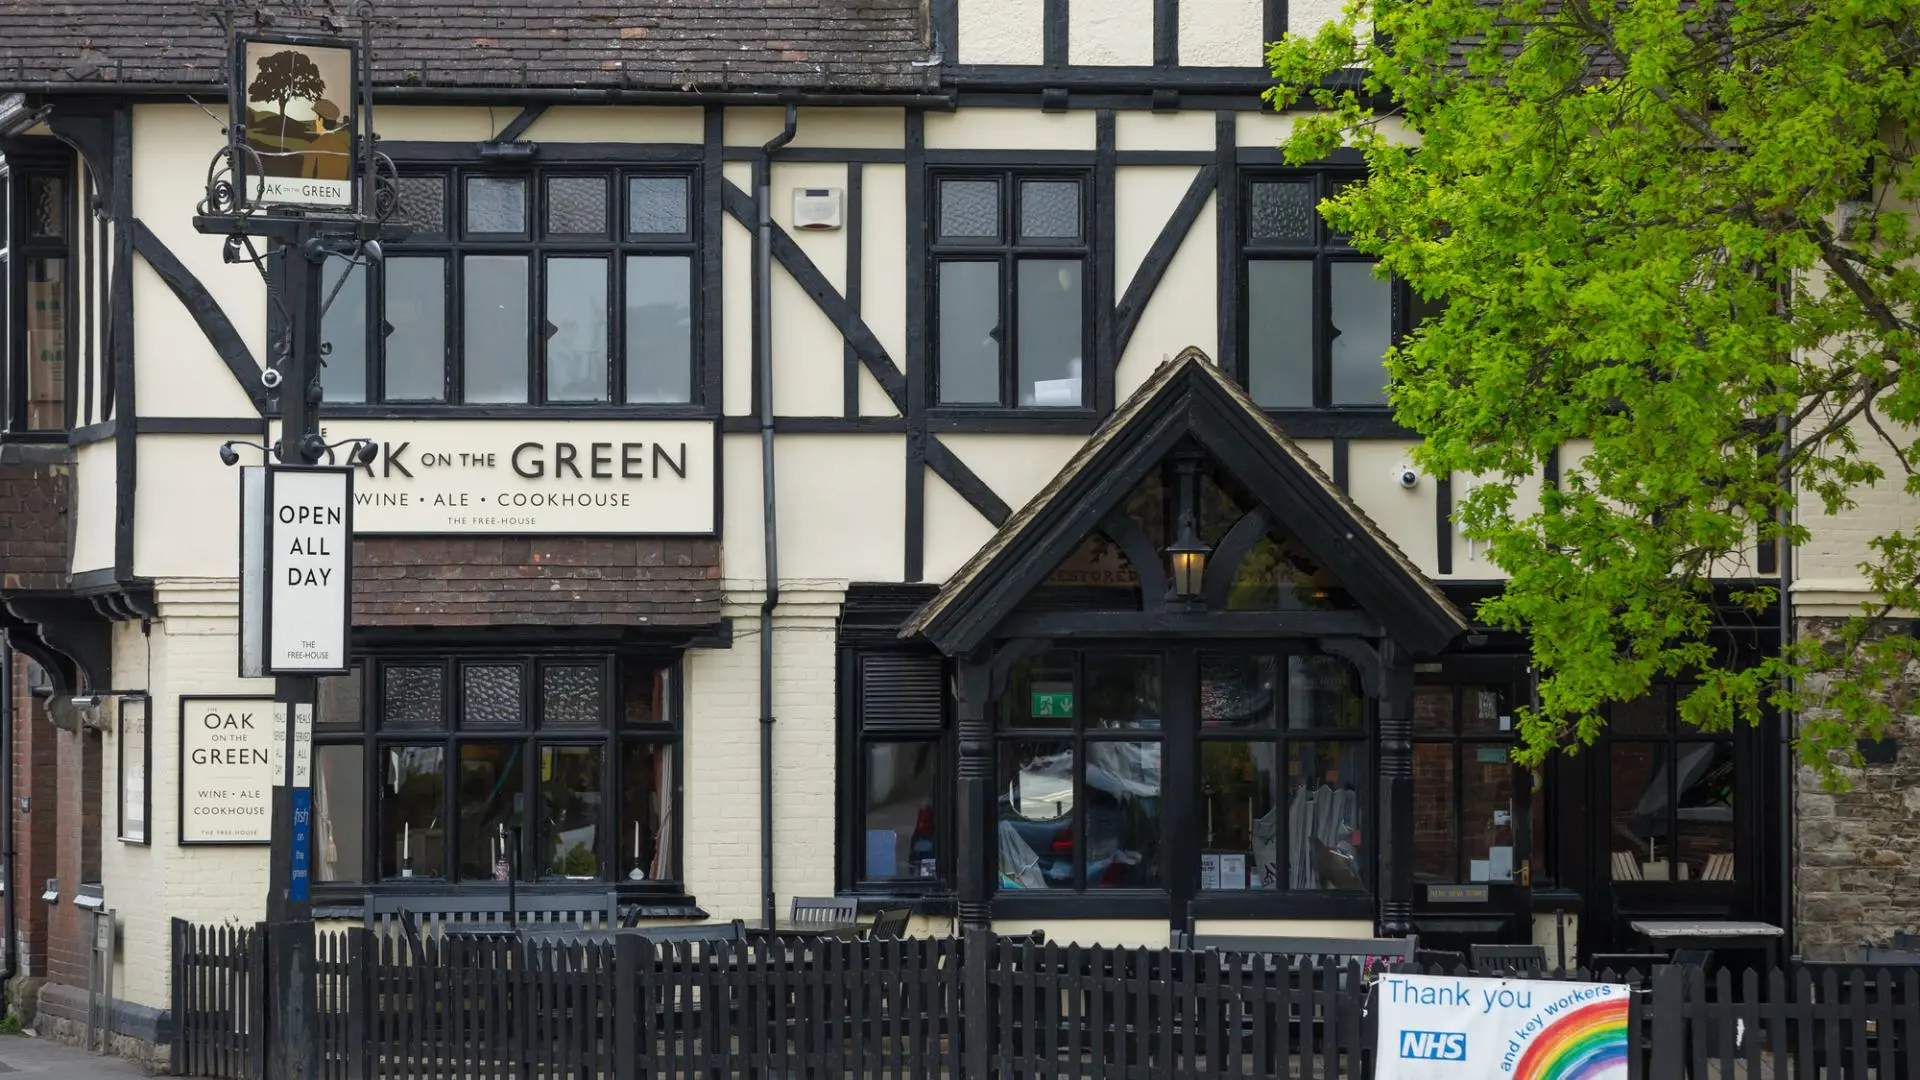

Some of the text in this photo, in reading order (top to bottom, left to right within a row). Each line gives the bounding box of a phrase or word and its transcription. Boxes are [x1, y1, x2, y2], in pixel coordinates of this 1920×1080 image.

[302, 185, 341, 198] GREEN
[421, 452, 451, 468] ON
[458, 452, 496, 468] THE
[511, 442, 687, 479] GREEN
[354, 493, 631, 507] WINE ALE COOKHOUSE
[279, 505, 341, 525] OPEN
[448, 516, 536, 526] THE FREE-HOUSE
[290, 537, 330, 556] ALL
[288, 568, 332, 587] DAY
[301, 641, 316, 649] THE
[287, 651, 329, 660] FREE-HOUSE
[204, 713, 255, 730] OAK
[211, 734, 247, 742] ON THE
[191, 748, 268, 765] GREEN
[198, 790, 261, 799] WINE ALE
[193, 806, 265, 816] COOKHOUSE
[1388, 979, 1532, 1014] Thank you
[1500, 984, 1612, 1072] and key workers
[1401, 1030, 1466, 1061] NHS
